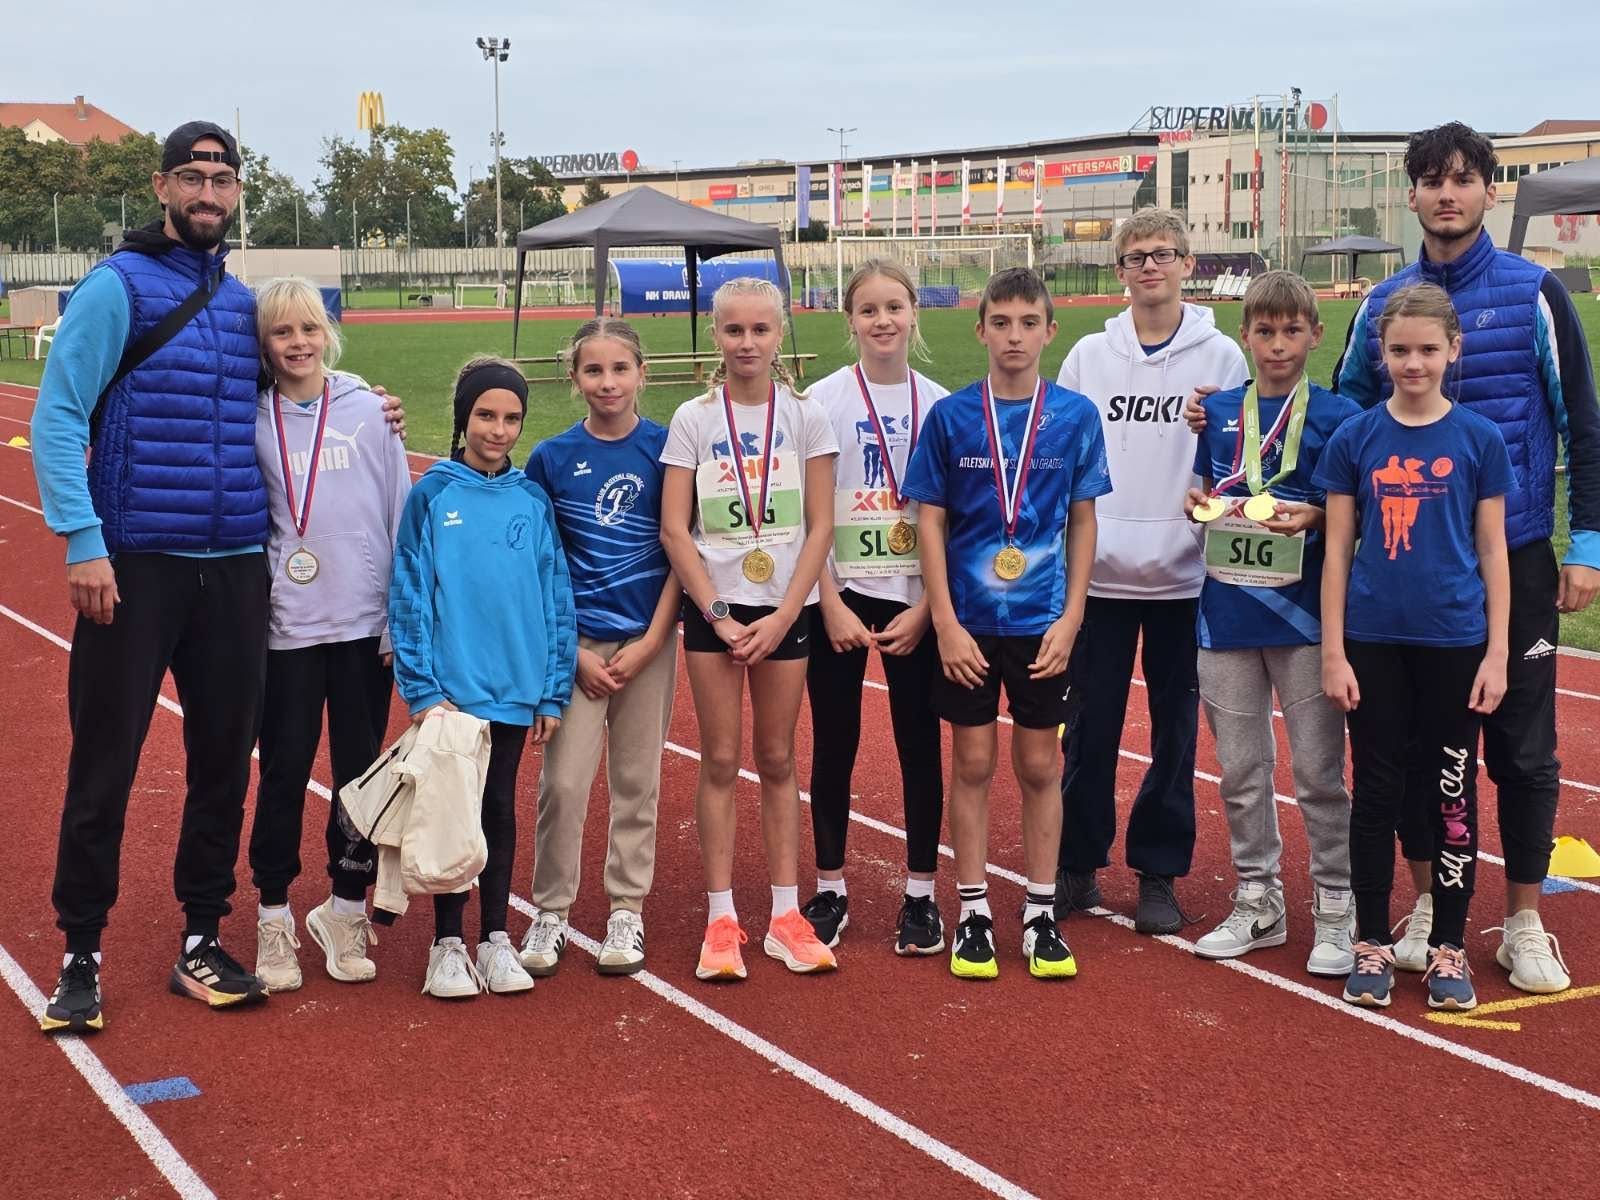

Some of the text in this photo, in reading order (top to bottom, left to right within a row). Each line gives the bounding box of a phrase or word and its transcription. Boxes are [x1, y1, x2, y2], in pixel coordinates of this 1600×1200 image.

[1150, 106, 1296, 130] SUPERNOVA
[1062, 161, 1120, 175] INTERSPAR
[645, 290, 660, 301] NK
[1107, 395, 1184, 424] SICK!
[288, 446, 350, 476] UMA
[959, 457, 991, 469] ATLETSKI
[860, 530, 887, 557] SL
[1229, 537, 1273, 567] SLG
[1438, 746, 1469, 798] Club
[1438, 851, 1473, 889] Self
